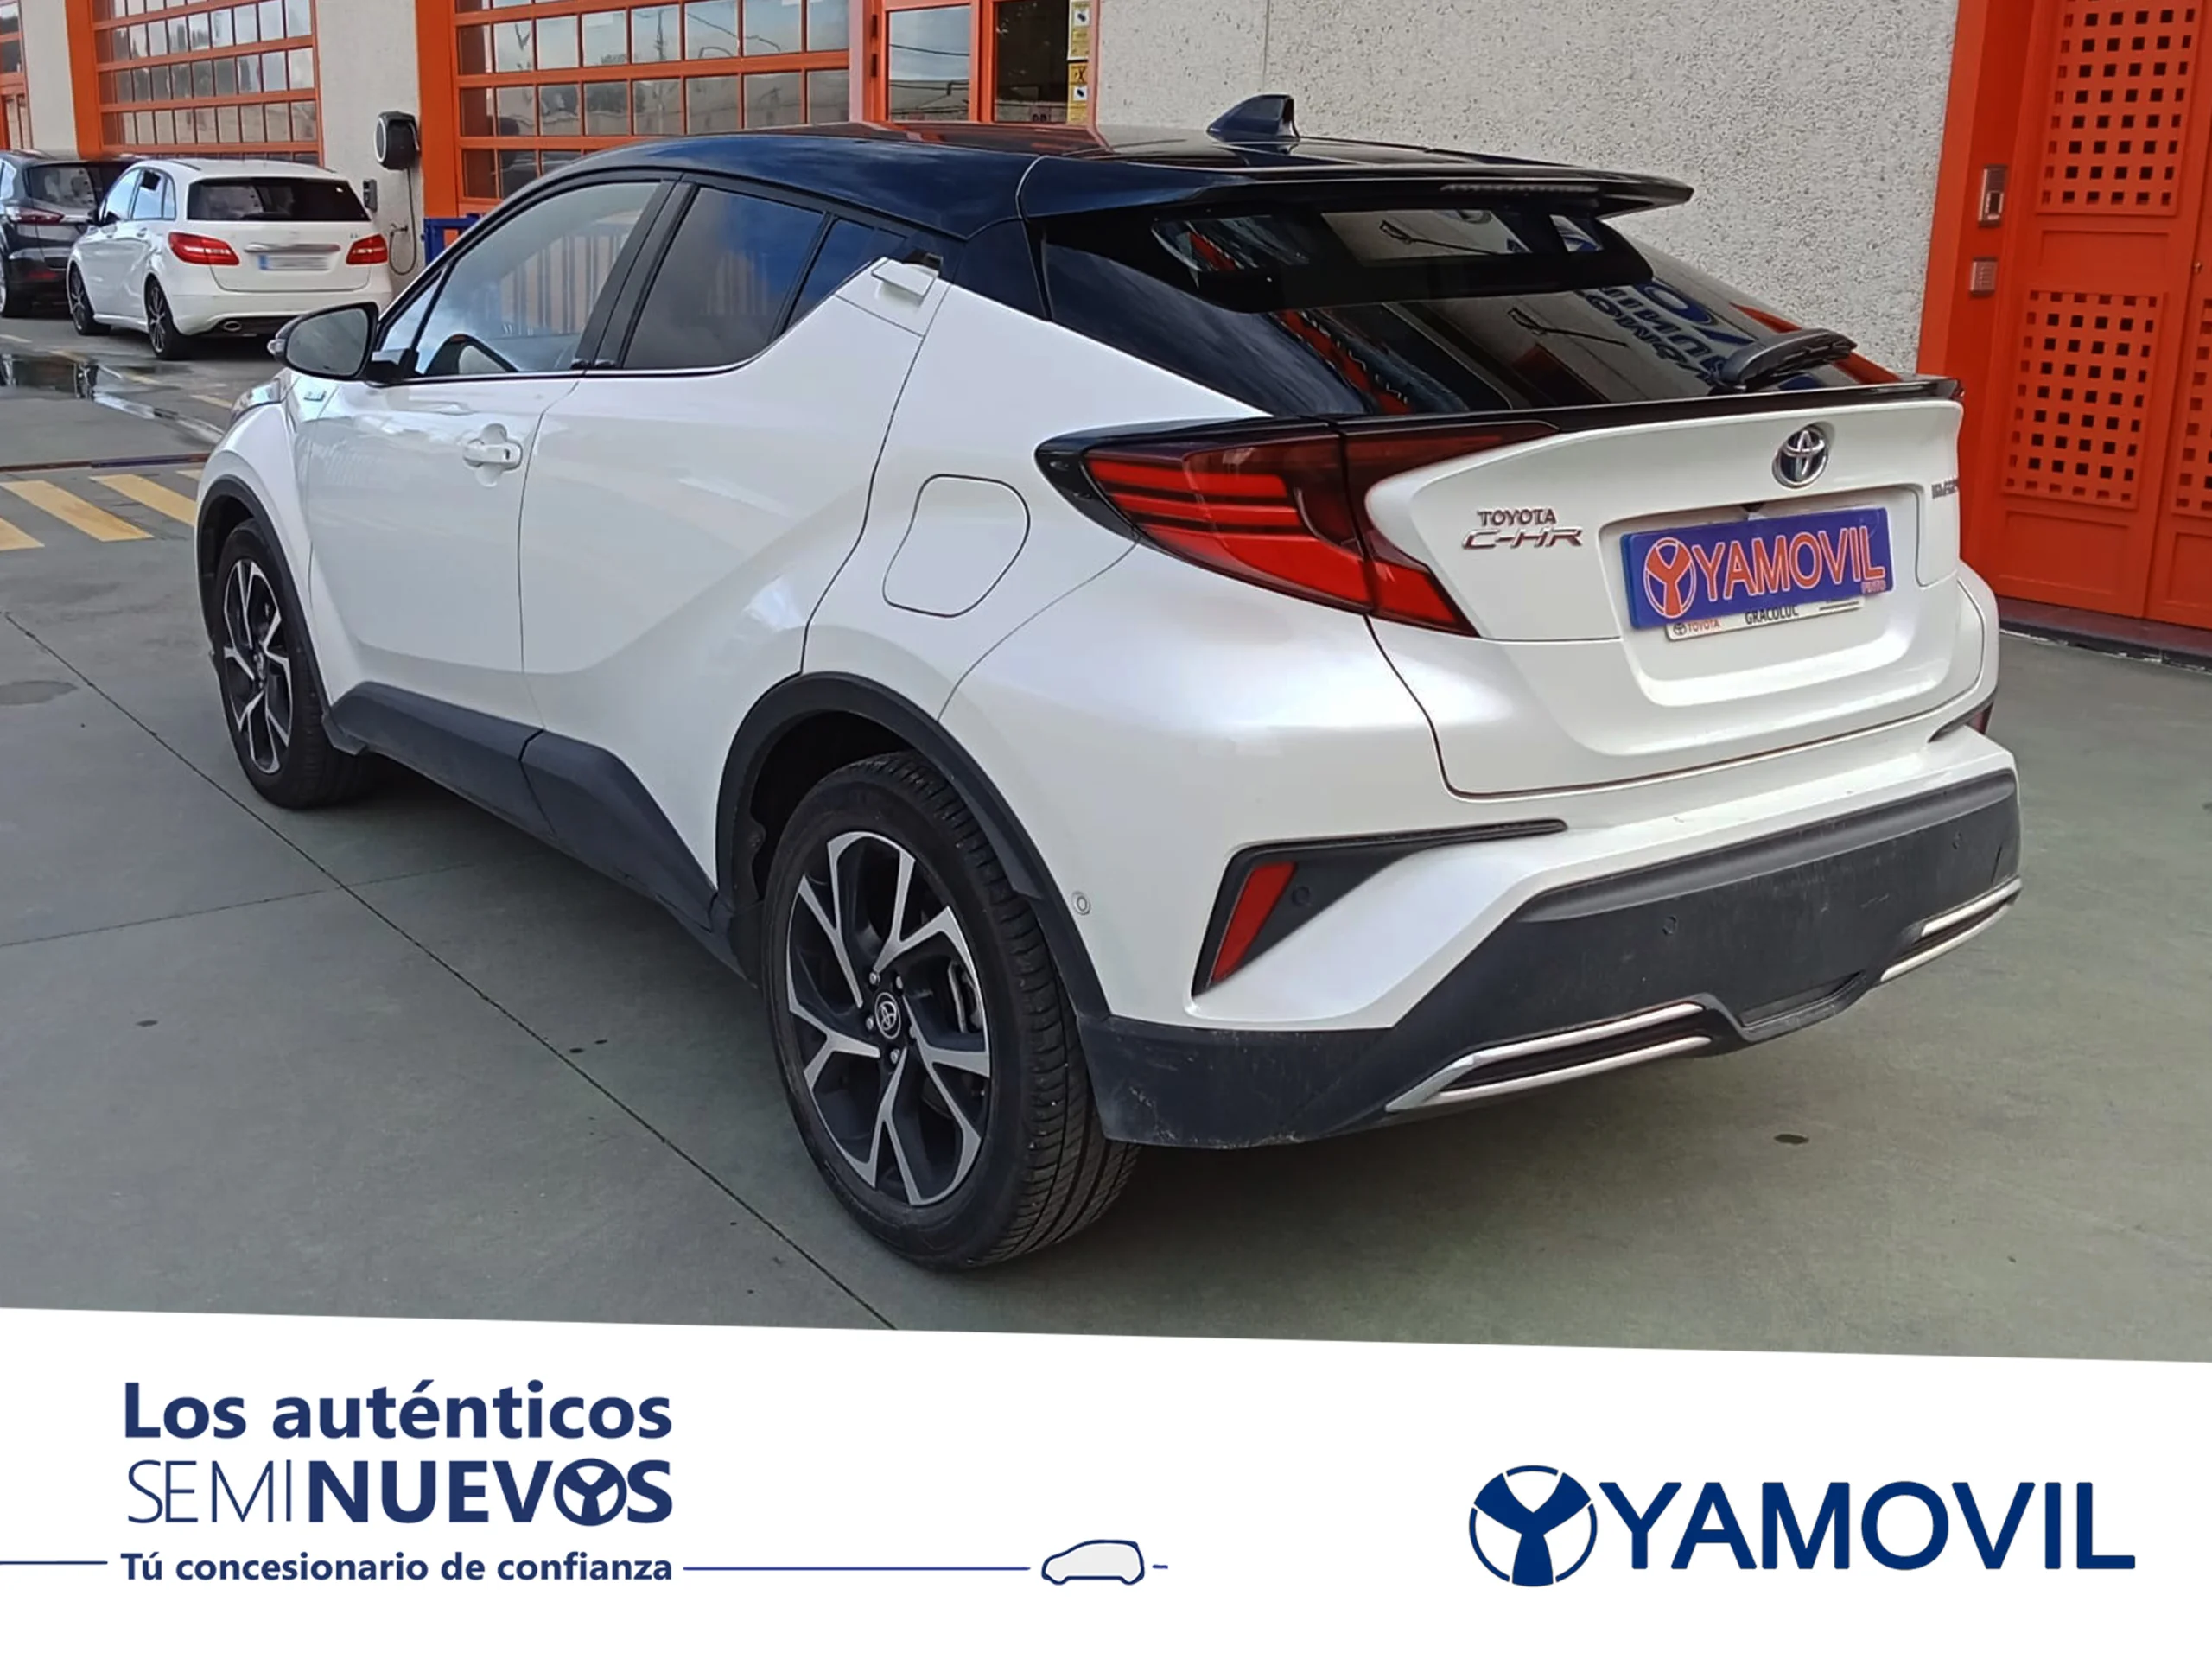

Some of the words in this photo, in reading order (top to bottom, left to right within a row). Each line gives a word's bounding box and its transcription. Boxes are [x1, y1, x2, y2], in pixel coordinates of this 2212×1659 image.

[1476, 507, 1558, 526] TOYOTA
[1461, 527, 1583, 549] C-HR
[1692, 526, 1885, 601] YAMOVIL
